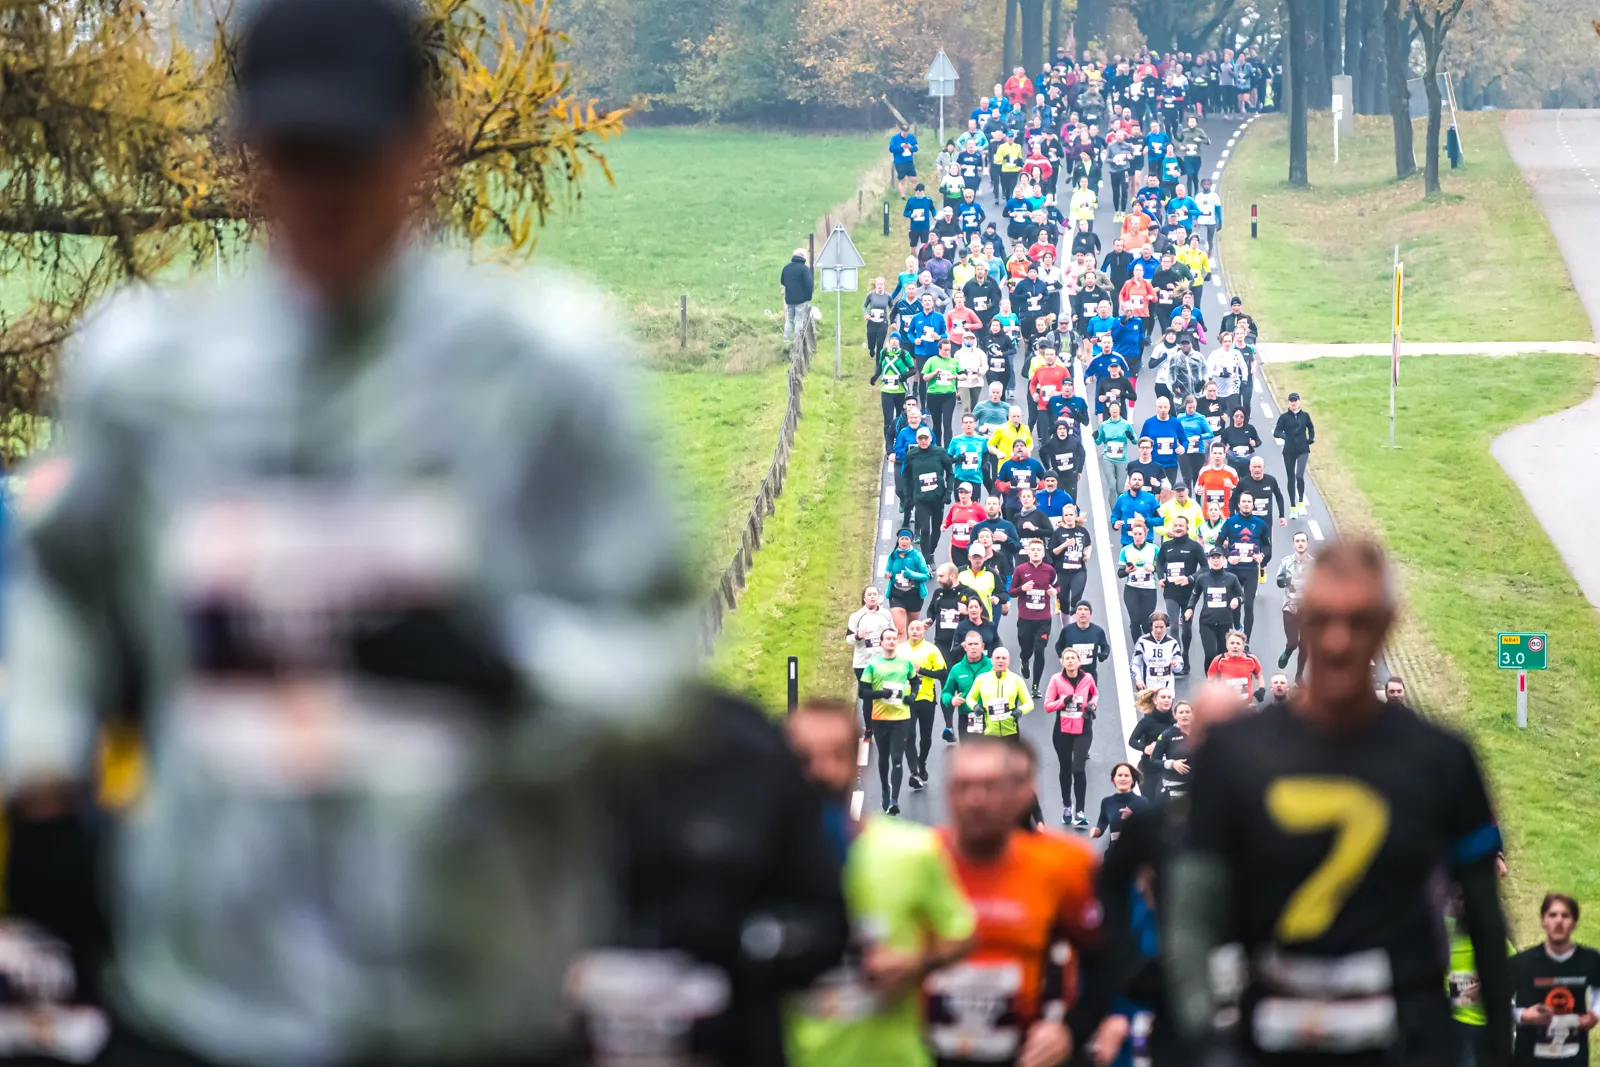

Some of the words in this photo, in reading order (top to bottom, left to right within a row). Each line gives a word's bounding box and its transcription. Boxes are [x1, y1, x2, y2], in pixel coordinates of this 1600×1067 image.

[1152, 648, 1163, 658] 16
[1502, 652, 1525, 664] 3.0
[1265, 776, 1390, 942] 7
